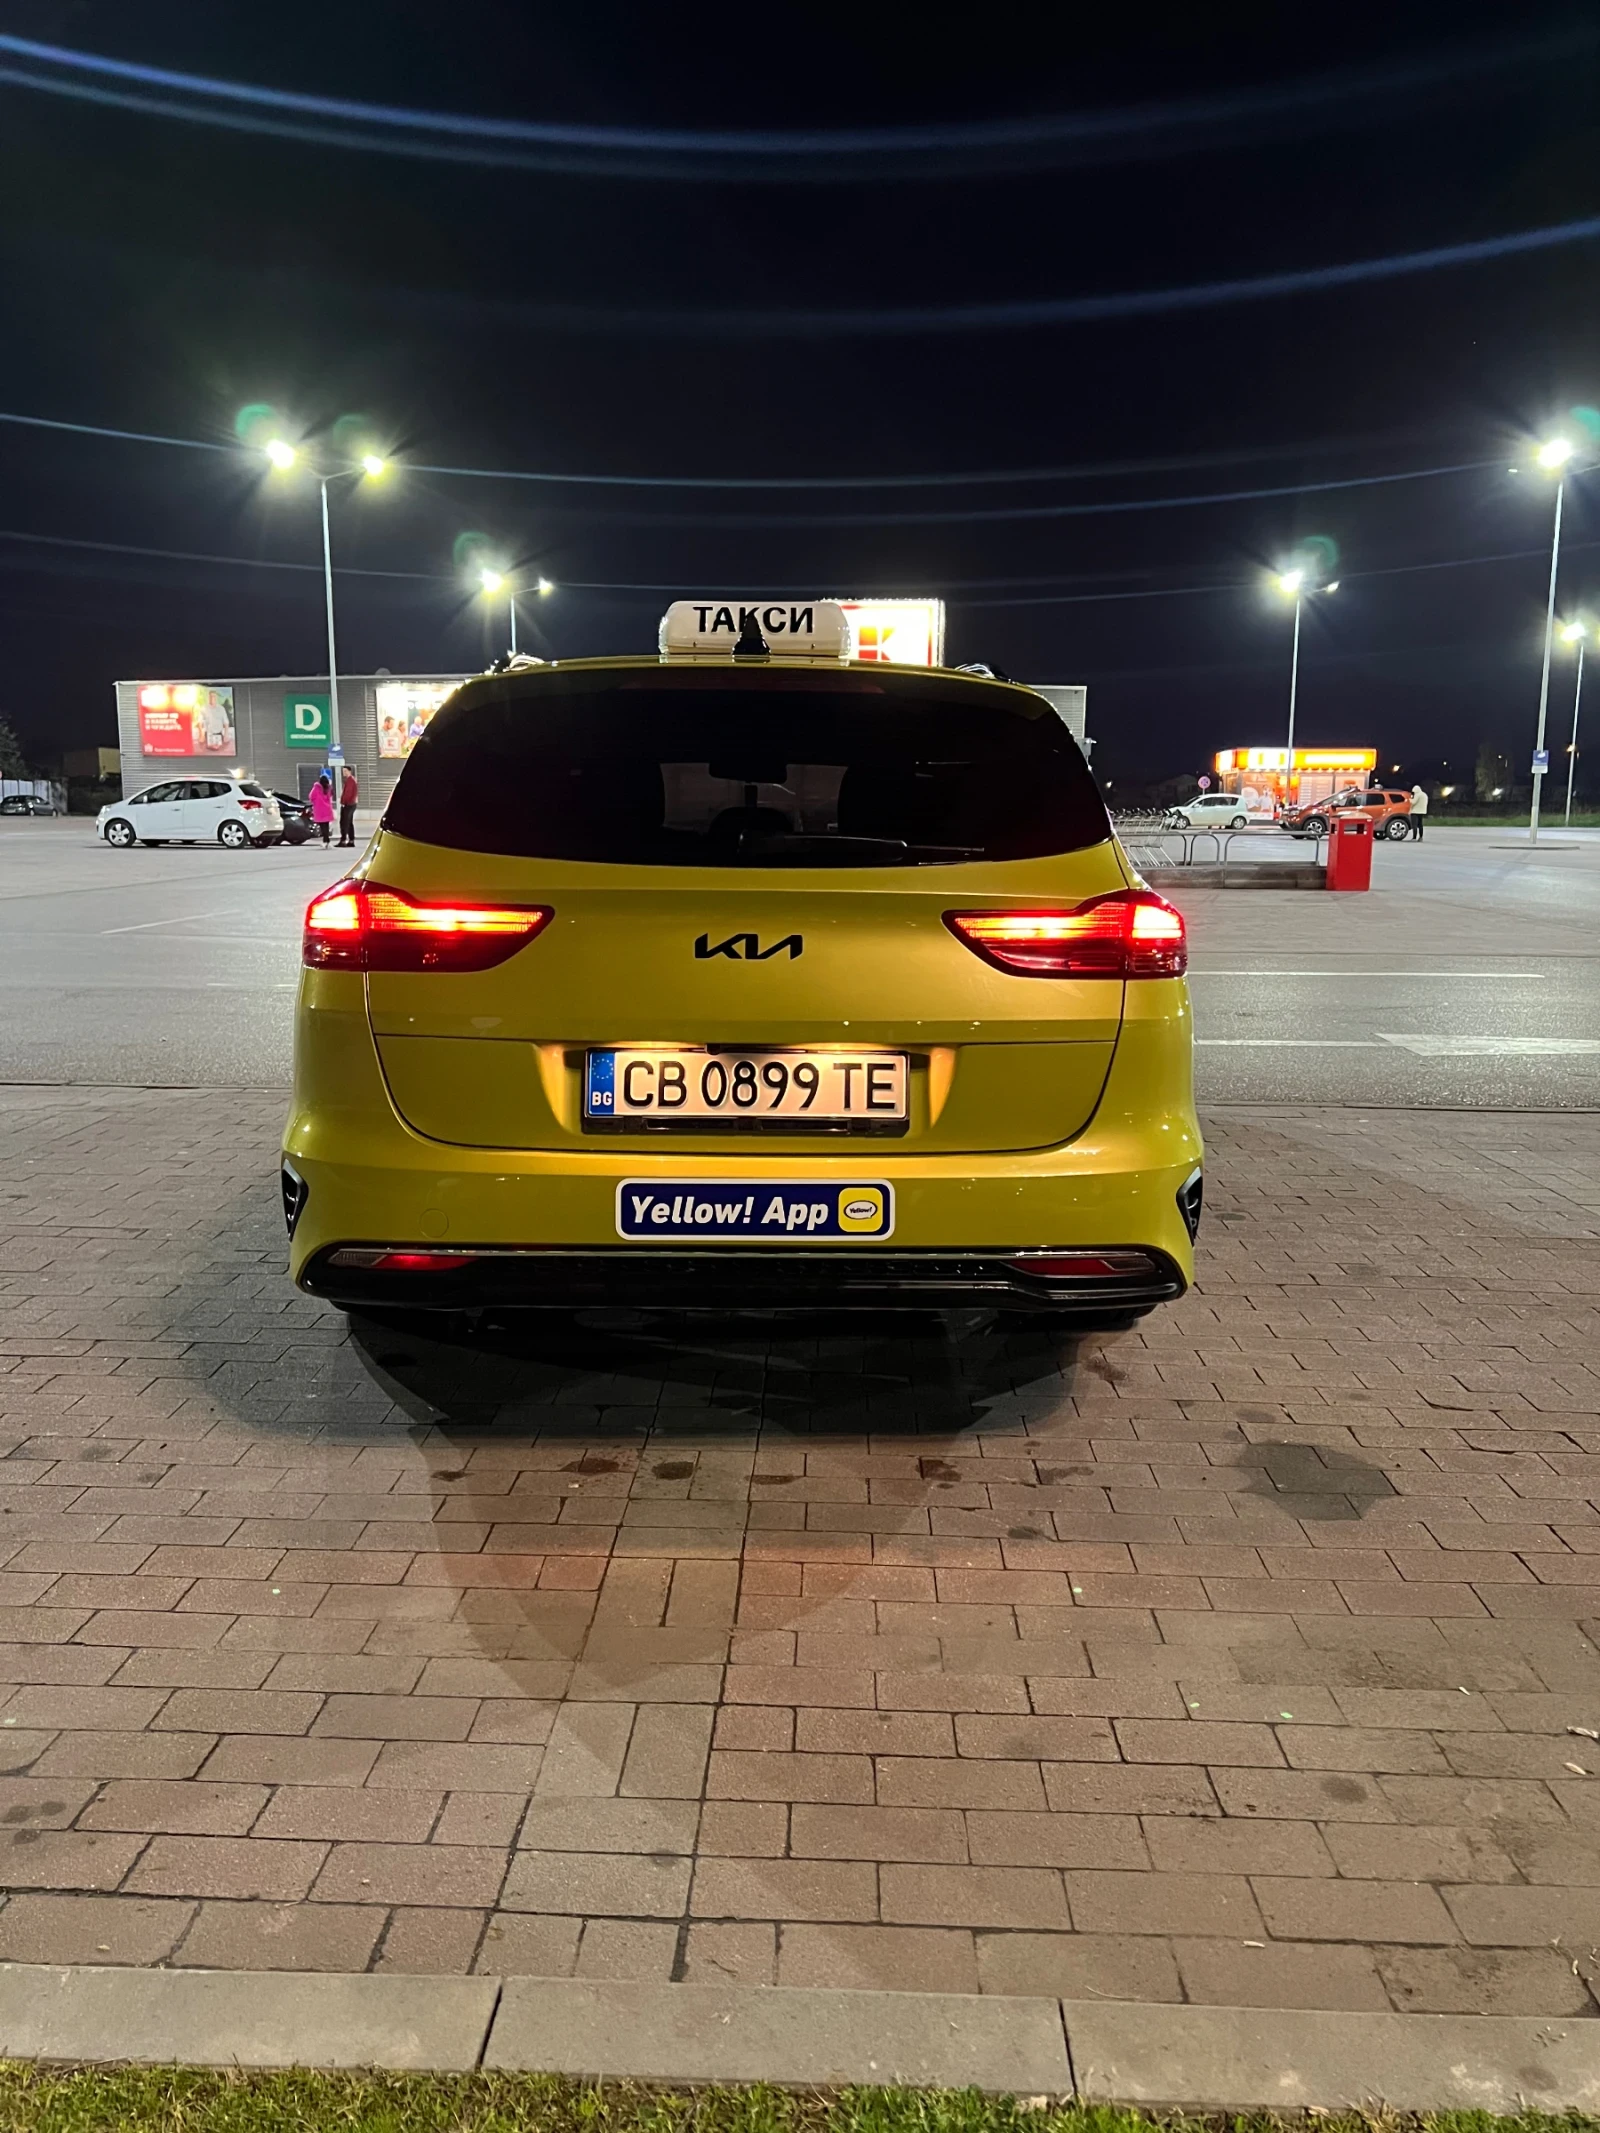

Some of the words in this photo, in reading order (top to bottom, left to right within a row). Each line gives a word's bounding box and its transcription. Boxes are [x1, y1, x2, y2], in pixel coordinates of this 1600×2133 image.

[295, 703, 322, 731] D
[592, 1092, 612, 1106] BG
[701, 1061, 819, 1109] 0899
[632, 1196, 754, 1224] Yellow!
[761, 1196, 829, 1231] App
